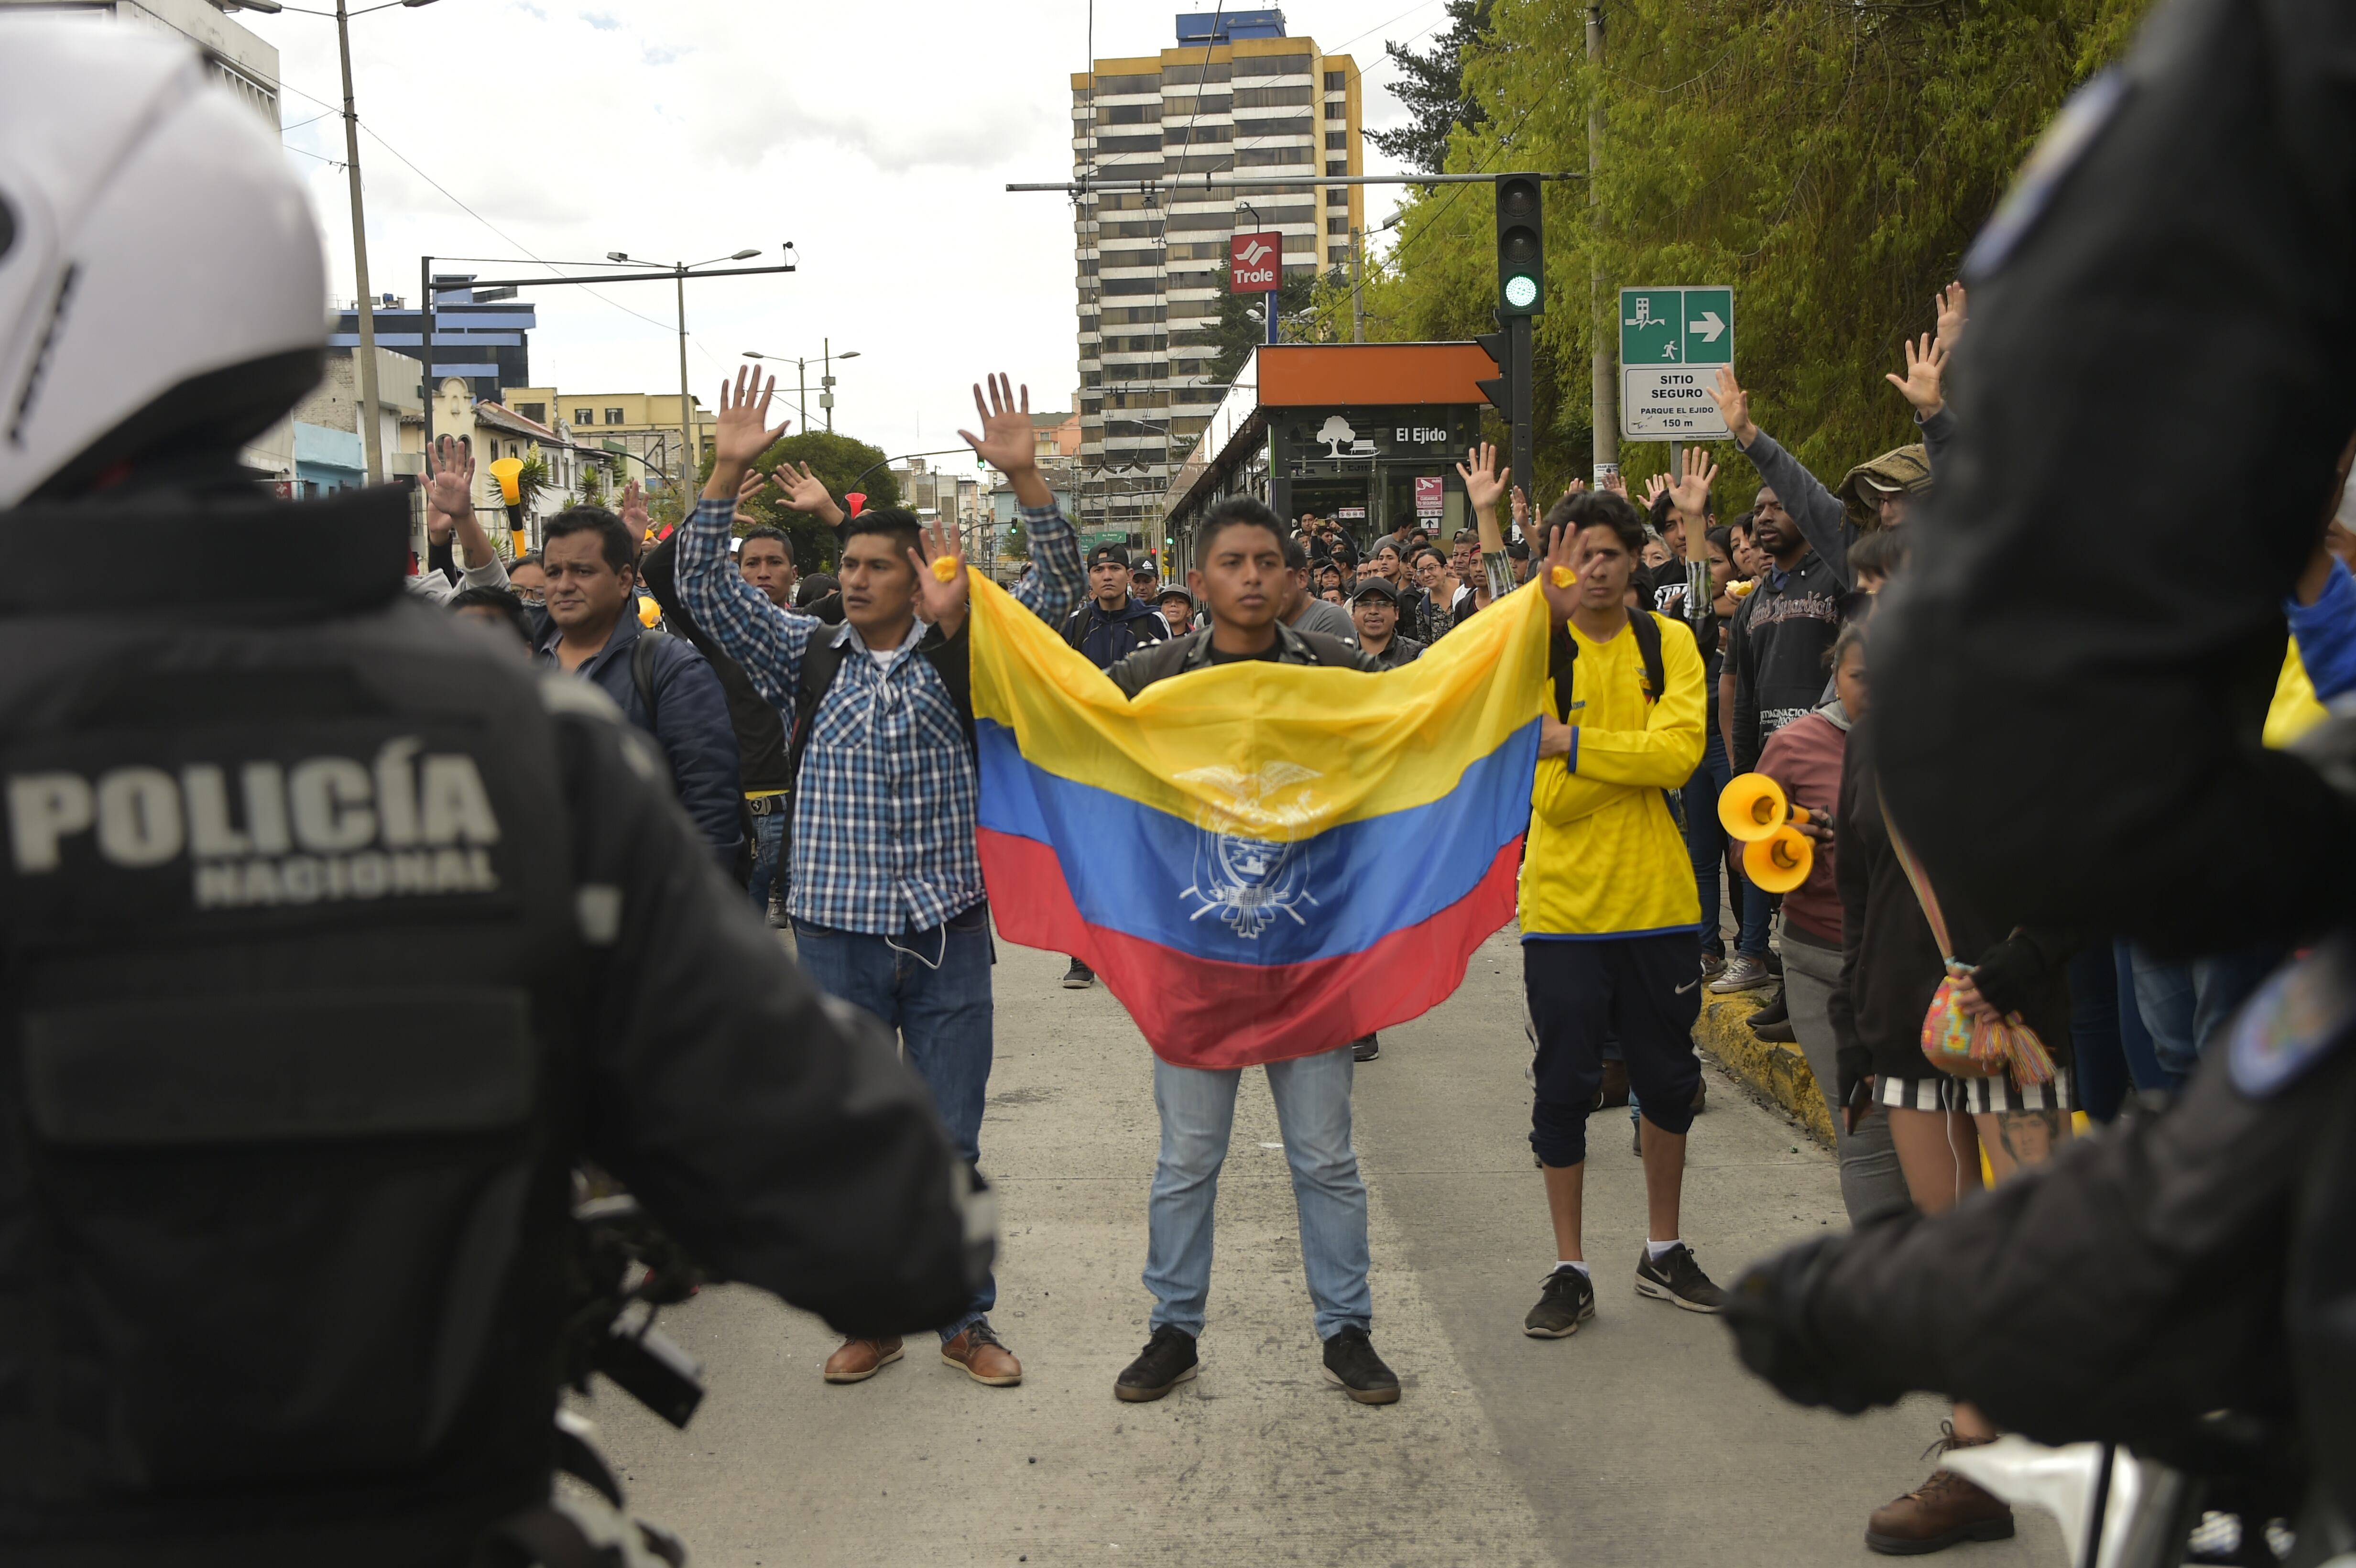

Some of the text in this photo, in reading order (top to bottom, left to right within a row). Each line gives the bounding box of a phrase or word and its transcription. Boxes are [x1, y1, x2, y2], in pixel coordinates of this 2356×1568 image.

[1234, 268, 1273, 283] Trole
[1660, 375, 1694, 384] SITIO
[1651, 389, 1703, 398] SEGURO
[1662, 419, 1680, 427] 150
[1396, 427, 1447, 445] El Ejido
[1760, 708, 1814, 721] IMAGINATION
[7, 736, 501, 874] POLICÍA
[195, 849, 500, 907] NACIONAL
